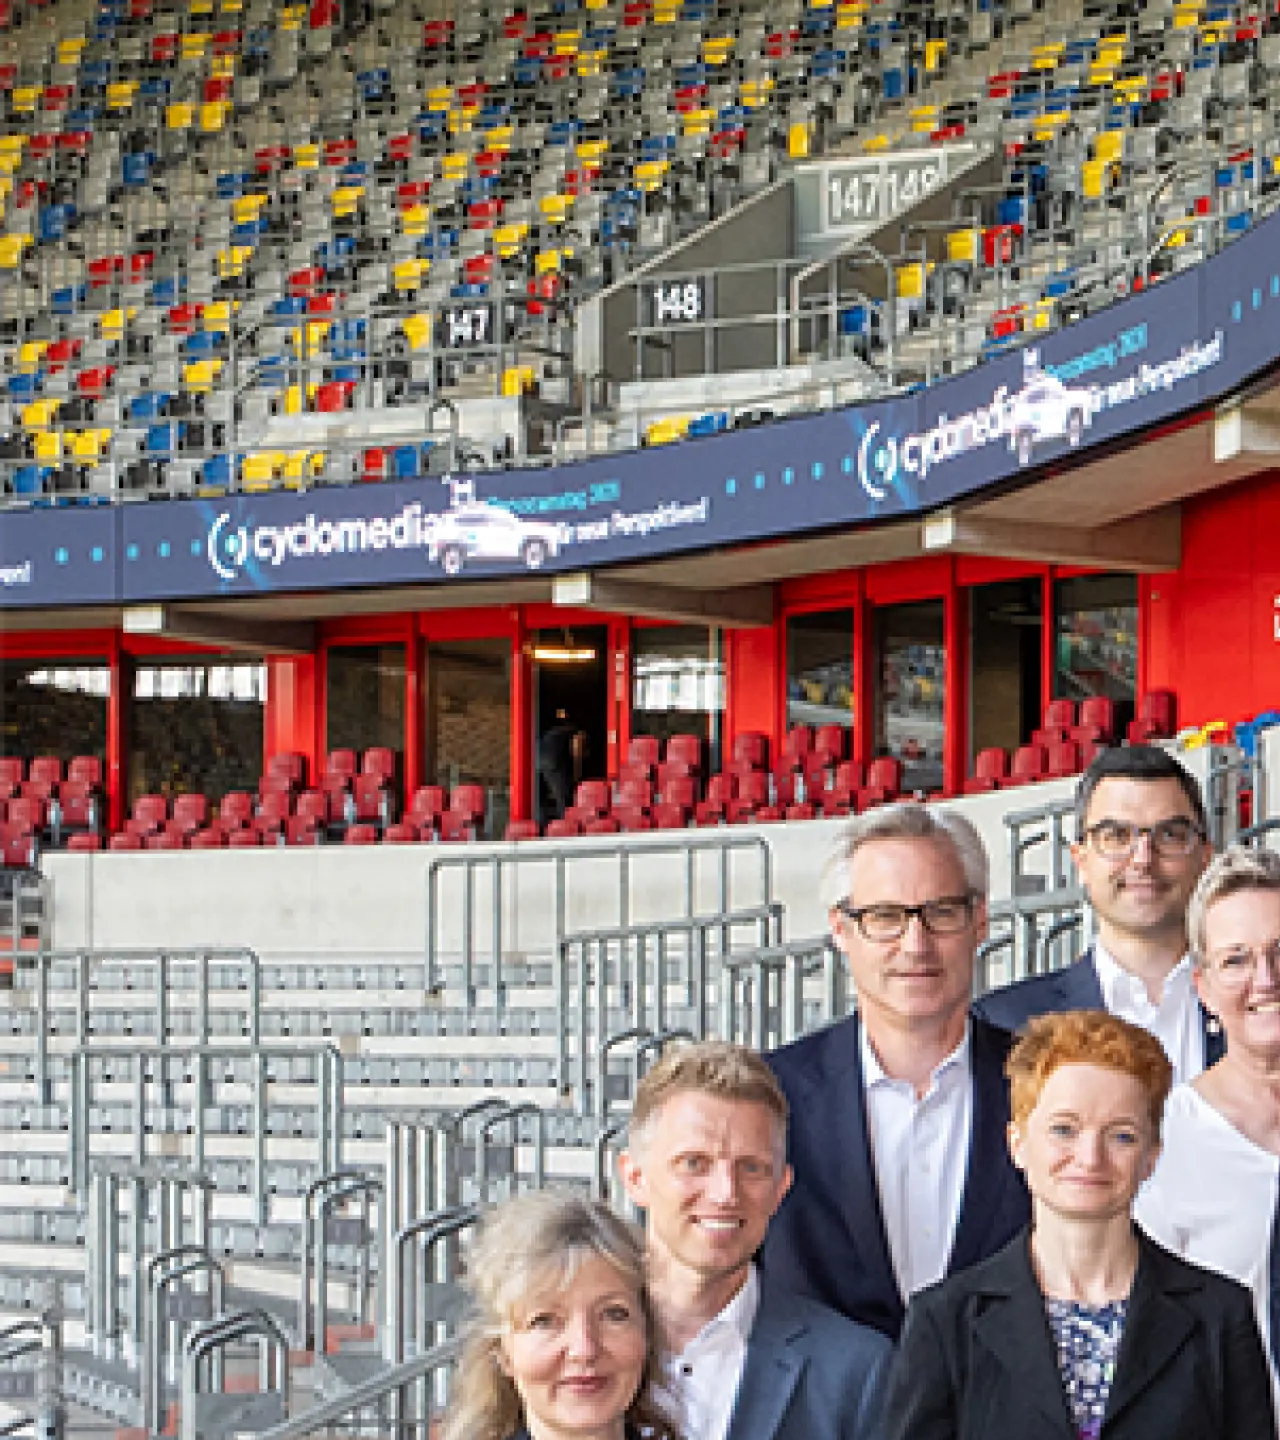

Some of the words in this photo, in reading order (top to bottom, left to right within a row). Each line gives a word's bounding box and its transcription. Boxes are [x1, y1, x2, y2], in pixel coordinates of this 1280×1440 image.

[828, 174, 880, 219] 147
[653, 283, 701, 319] 148
[447, 309, 490, 343] 147
[252, 501, 447, 565] cyclomedia
